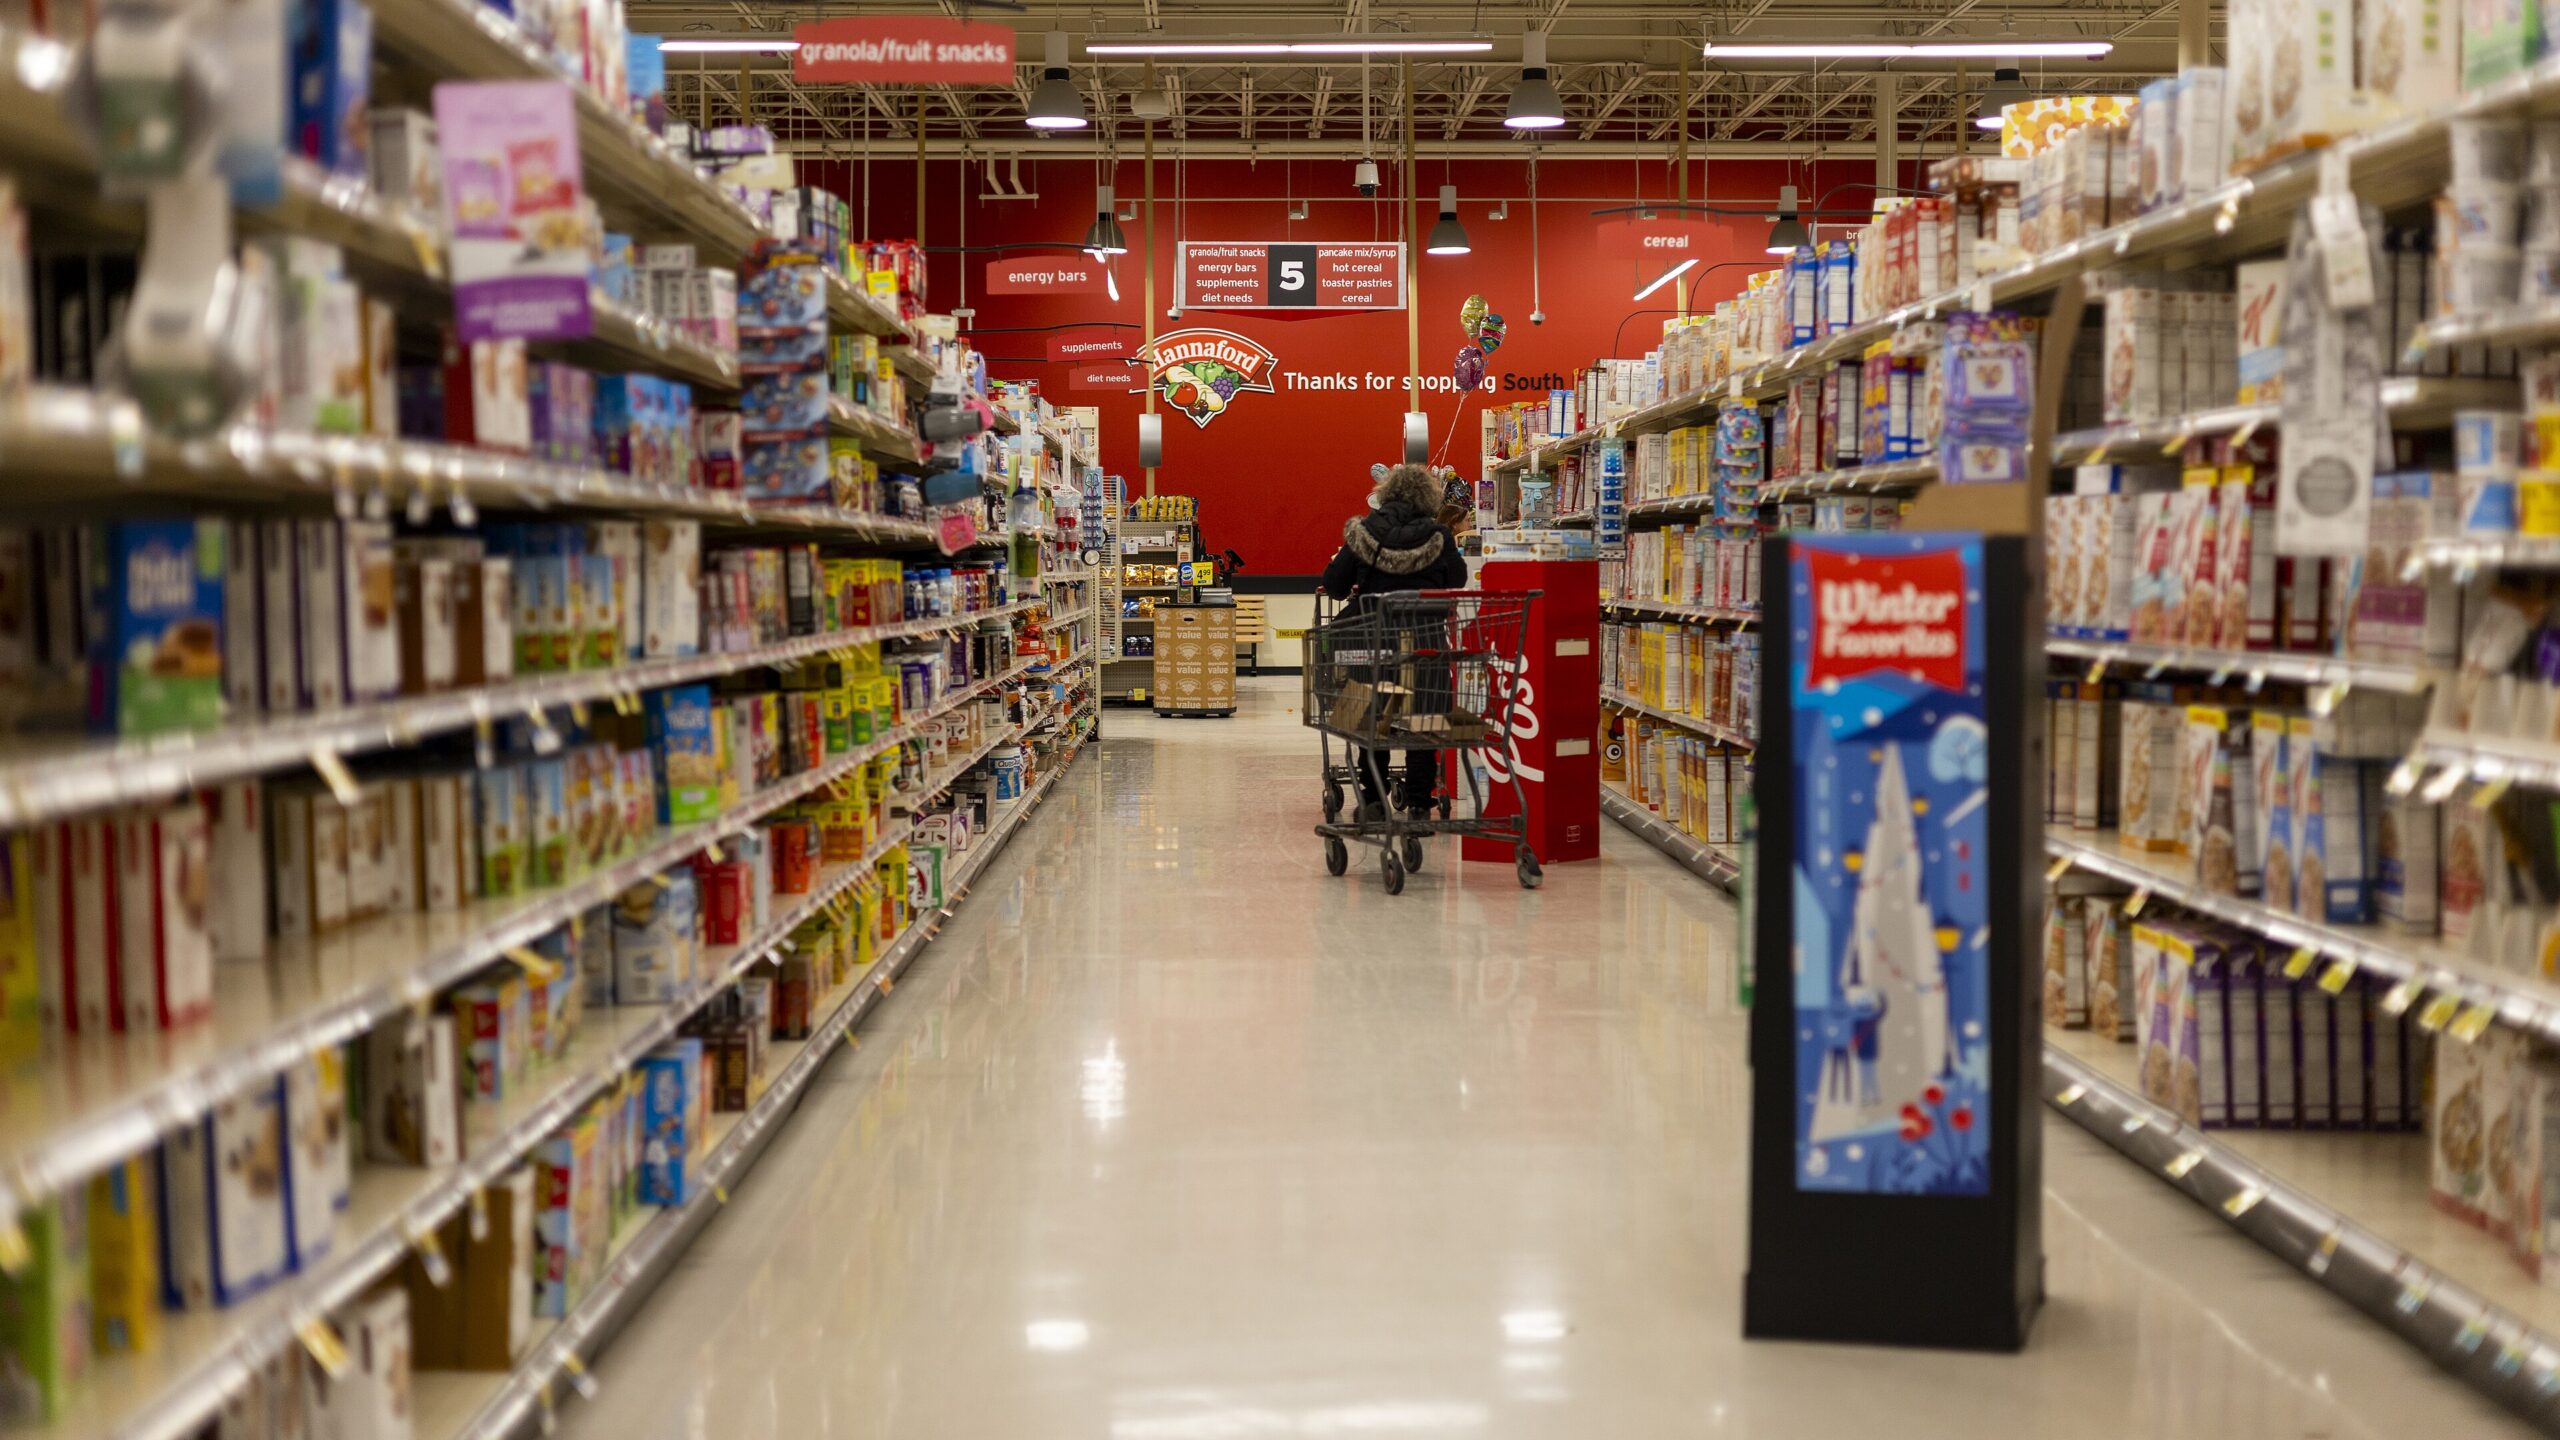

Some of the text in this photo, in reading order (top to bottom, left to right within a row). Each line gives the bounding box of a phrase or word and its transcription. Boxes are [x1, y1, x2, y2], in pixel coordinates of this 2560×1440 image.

[801, 37, 1007, 64] granola/fruit snacks
[1643, 235, 1689, 248] cereal
[1189, 247, 1266, 257] granola/fruit snacks
[1318, 247, 1397, 258] pancake mix/syrup
[1198, 263, 1257, 274] energy bars
[1332, 263, 1382, 273] hot cereal
[1008, 270, 1087, 284] energy bars
[1279, 260, 1305, 291] 5
[1196, 278, 1259, 288] supplements
[1322, 278, 1393, 289] toaster pastries
[1202, 293, 1253, 303] diet needs
[1342, 293, 1373, 303] cereal
[1061, 340, 1123, 353] supplements
[1087, 373, 1131, 383] diet needs
[1283, 371, 1564, 394] Thanks for soppg South
[1820, 578, 1959, 625] Winter
[1177, 631, 1202, 639] value
[1820, 622, 1959, 659] Favorites
[1177, 666, 1202, 674] value
